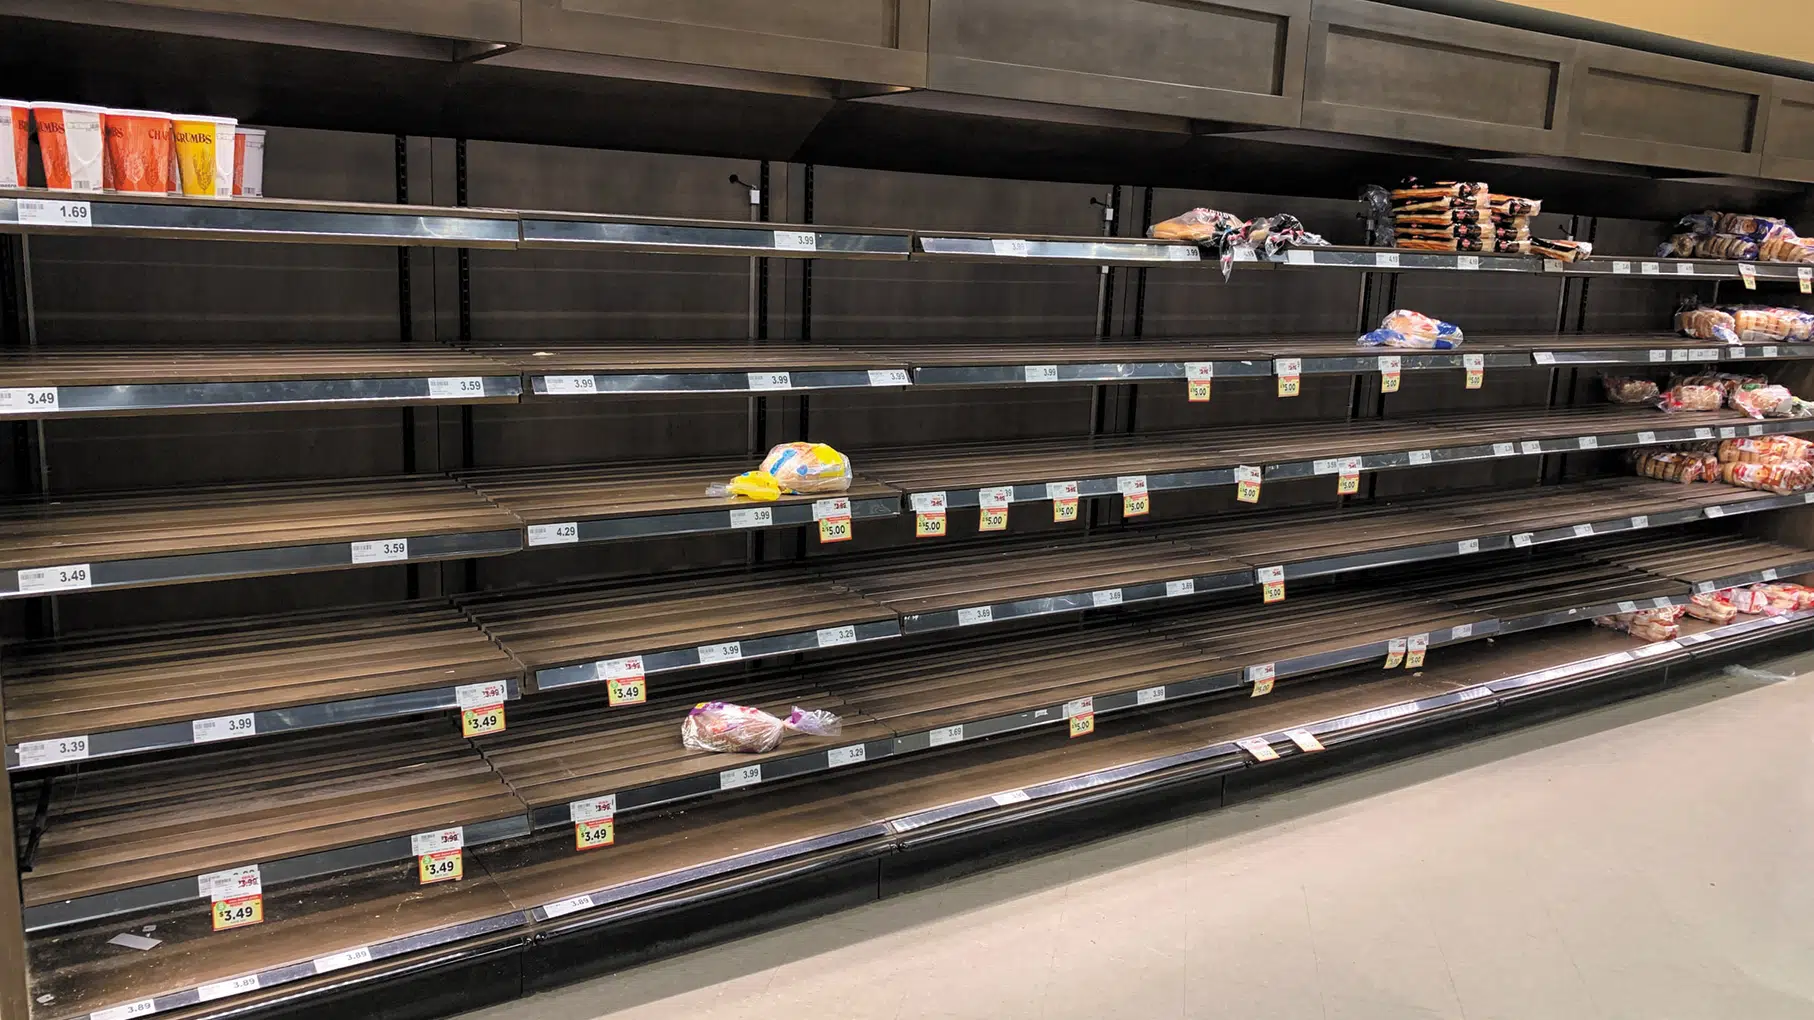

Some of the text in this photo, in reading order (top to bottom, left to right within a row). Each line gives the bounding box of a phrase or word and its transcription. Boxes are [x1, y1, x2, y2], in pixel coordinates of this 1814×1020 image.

[60, 206, 87, 218] 1.69
[798, 235, 814, 246] 3.99
[890, 372, 905, 381] 3.99
[1043, 368, 1057, 377] 3.99
[574, 379, 593, 389] 3.99
[771, 375, 788, 385] 3.99
[460, 381, 481, 391] 3.59
[27, 393, 54, 404] 3.49
[754, 511, 770, 521] 3.99
[556, 527, 576, 537] 4.29
[383, 543, 405, 554] 3.59
[60, 569, 86, 582] 3.49
[977, 609, 991, 618] 3.69
[839, 629, 854, 639] 3.29
[723, 645, 739, 655] 3.99
[614, 686, 639, 698] $3.49
[228, 718, 252, 731] 3.99
[468, 715, 497, 729] $3.49
[948, 727, 962, 737] 3.69
[59, 741, 85, 754] 3.39
[849, 748, 864, 758] 3.29
[743, 769, 759, 779] 3.99
[581, 829, 607, 841] $3.49
[425, 861, 454, 875] $3.49
[219, 906, 253, 921] $3.49
[347, 950, 368, 961] 3.89
[233, 977, 256, 989] 3.89
[127, 1002, 151, 1014] 3.89
